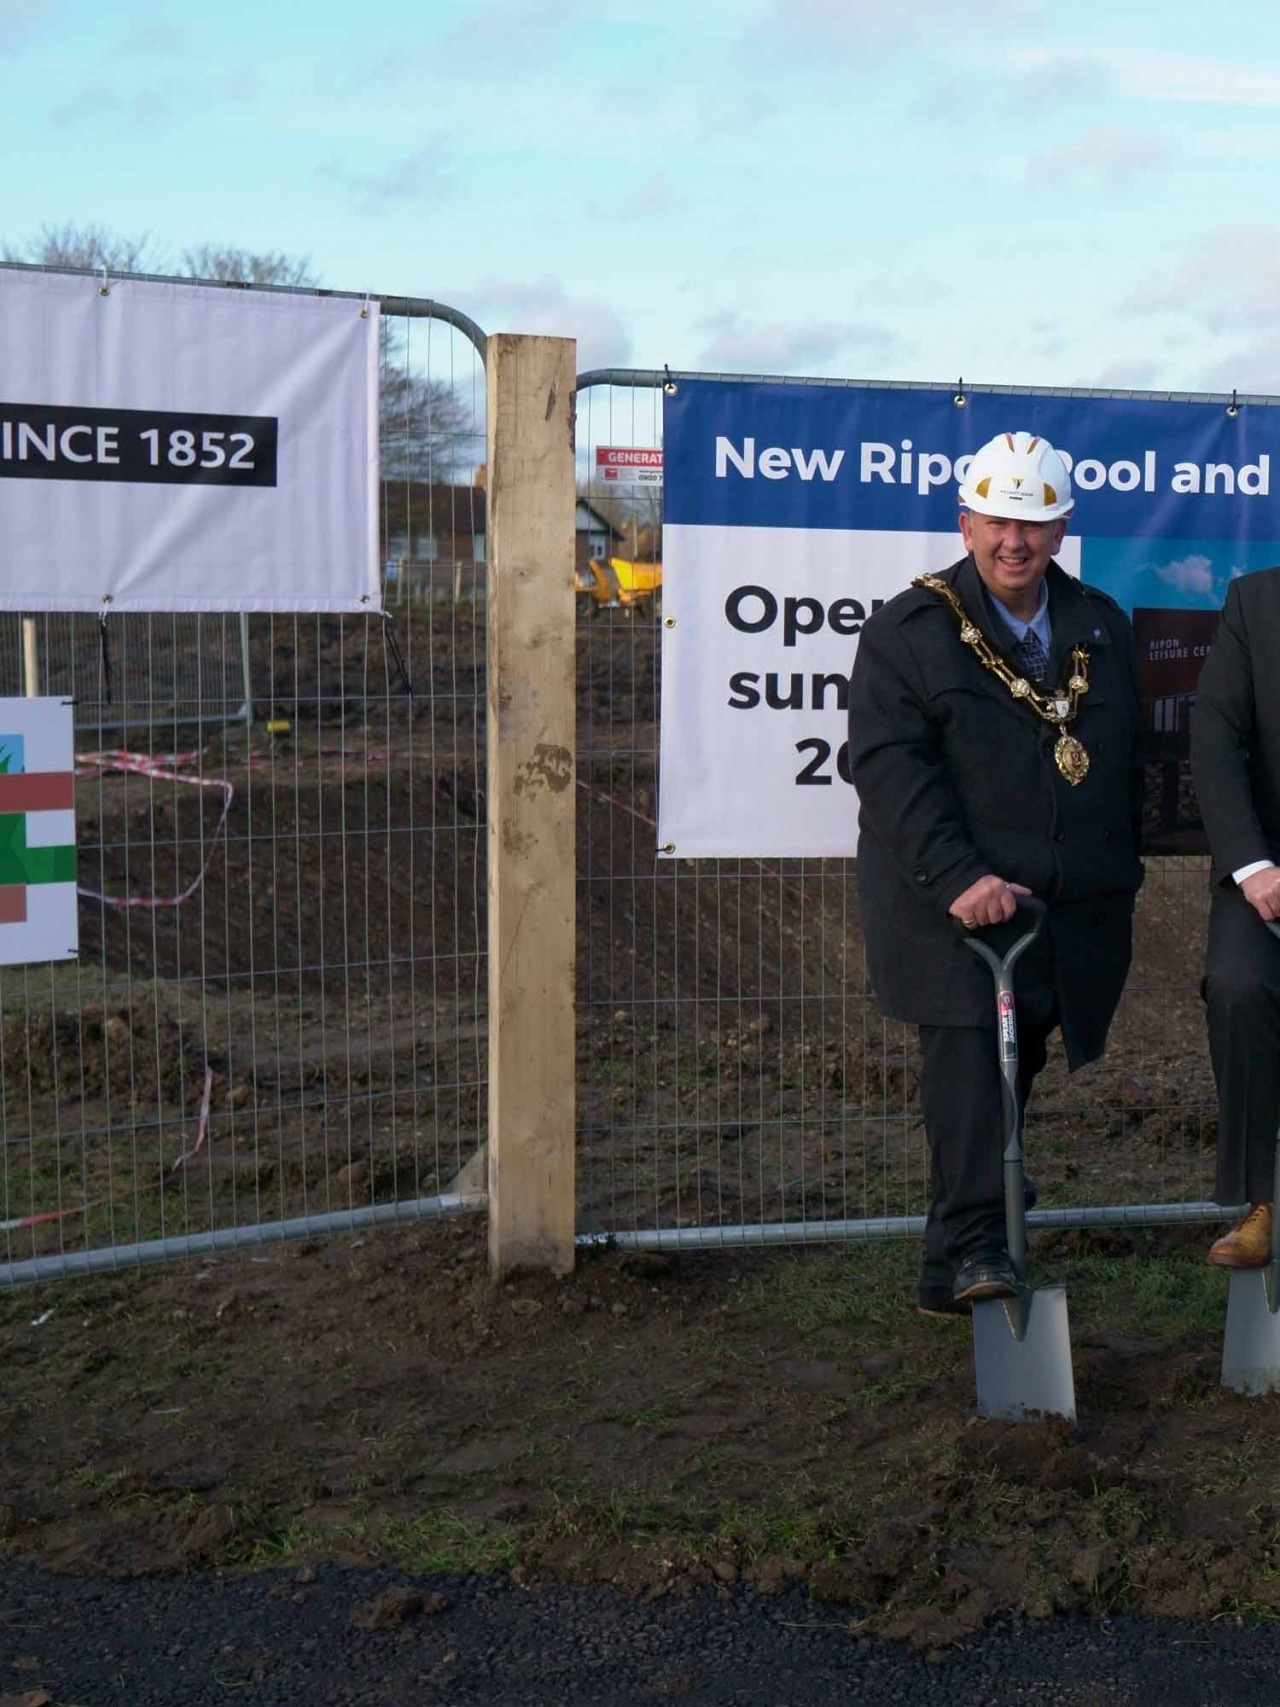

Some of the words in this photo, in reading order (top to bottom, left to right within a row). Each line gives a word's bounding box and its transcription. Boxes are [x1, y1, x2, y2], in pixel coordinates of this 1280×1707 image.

[140, 429, 255, 469] 1852
[609, 452, 663, 464] GENERAT
[715, 437, 845, 481] New
[1171, 454, 1270, 496] and
[725, 585, 886, 647] Ope
